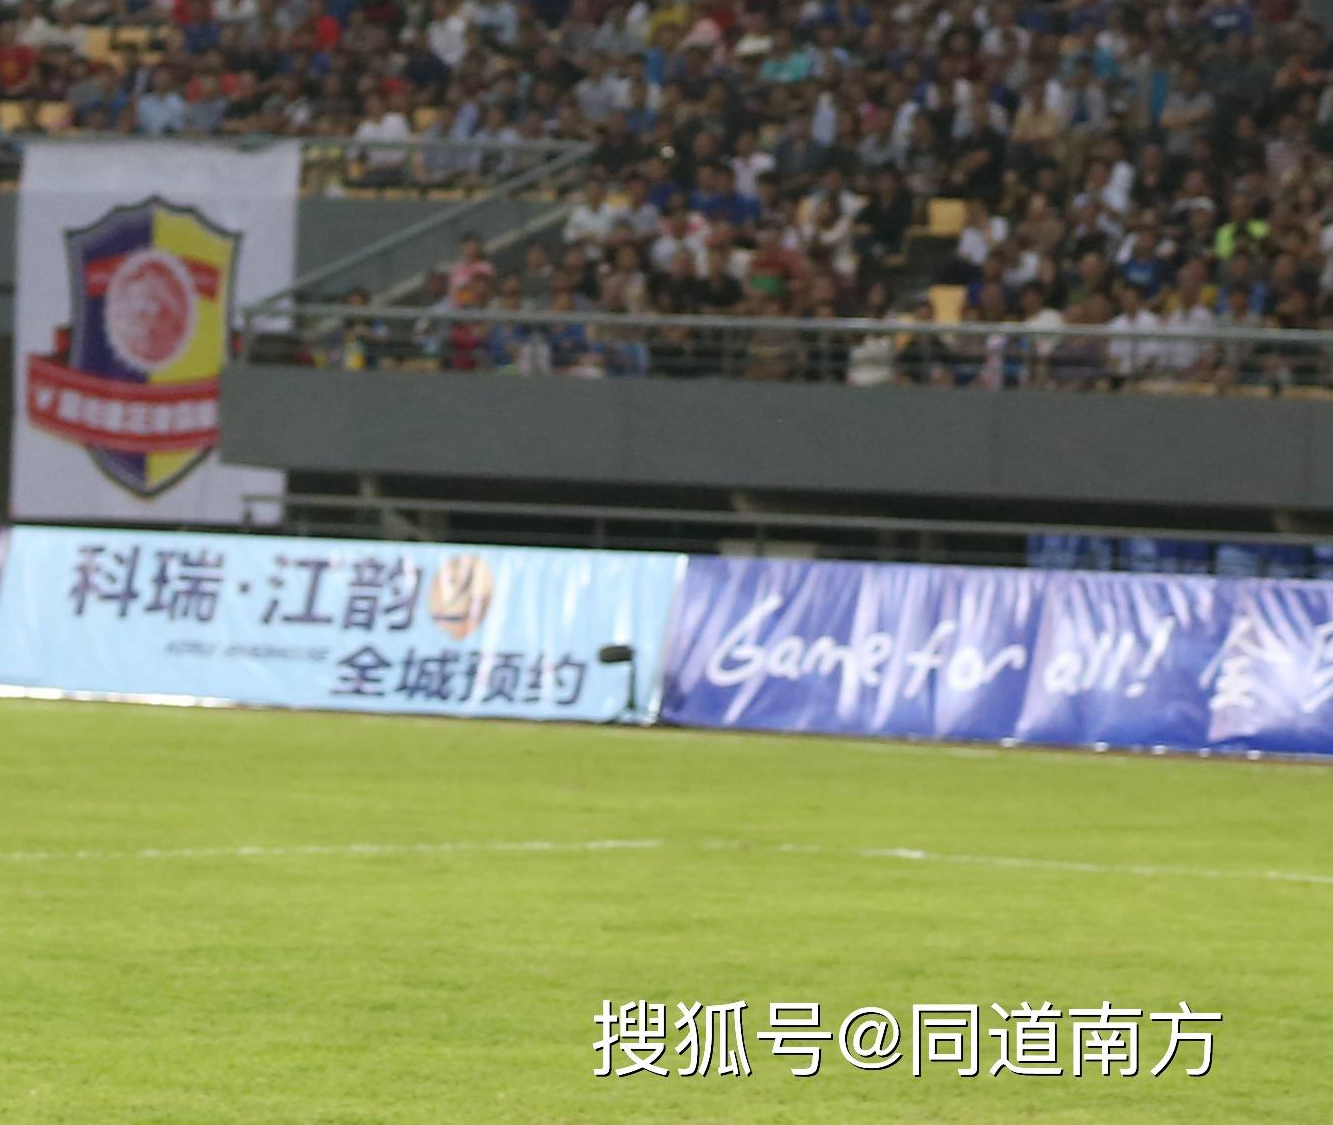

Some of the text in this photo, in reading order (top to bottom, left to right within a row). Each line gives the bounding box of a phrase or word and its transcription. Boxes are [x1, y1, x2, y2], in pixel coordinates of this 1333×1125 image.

[331, 645, 587, 705] 全城预约
[706, 595, 1175, 699] Game for all!
